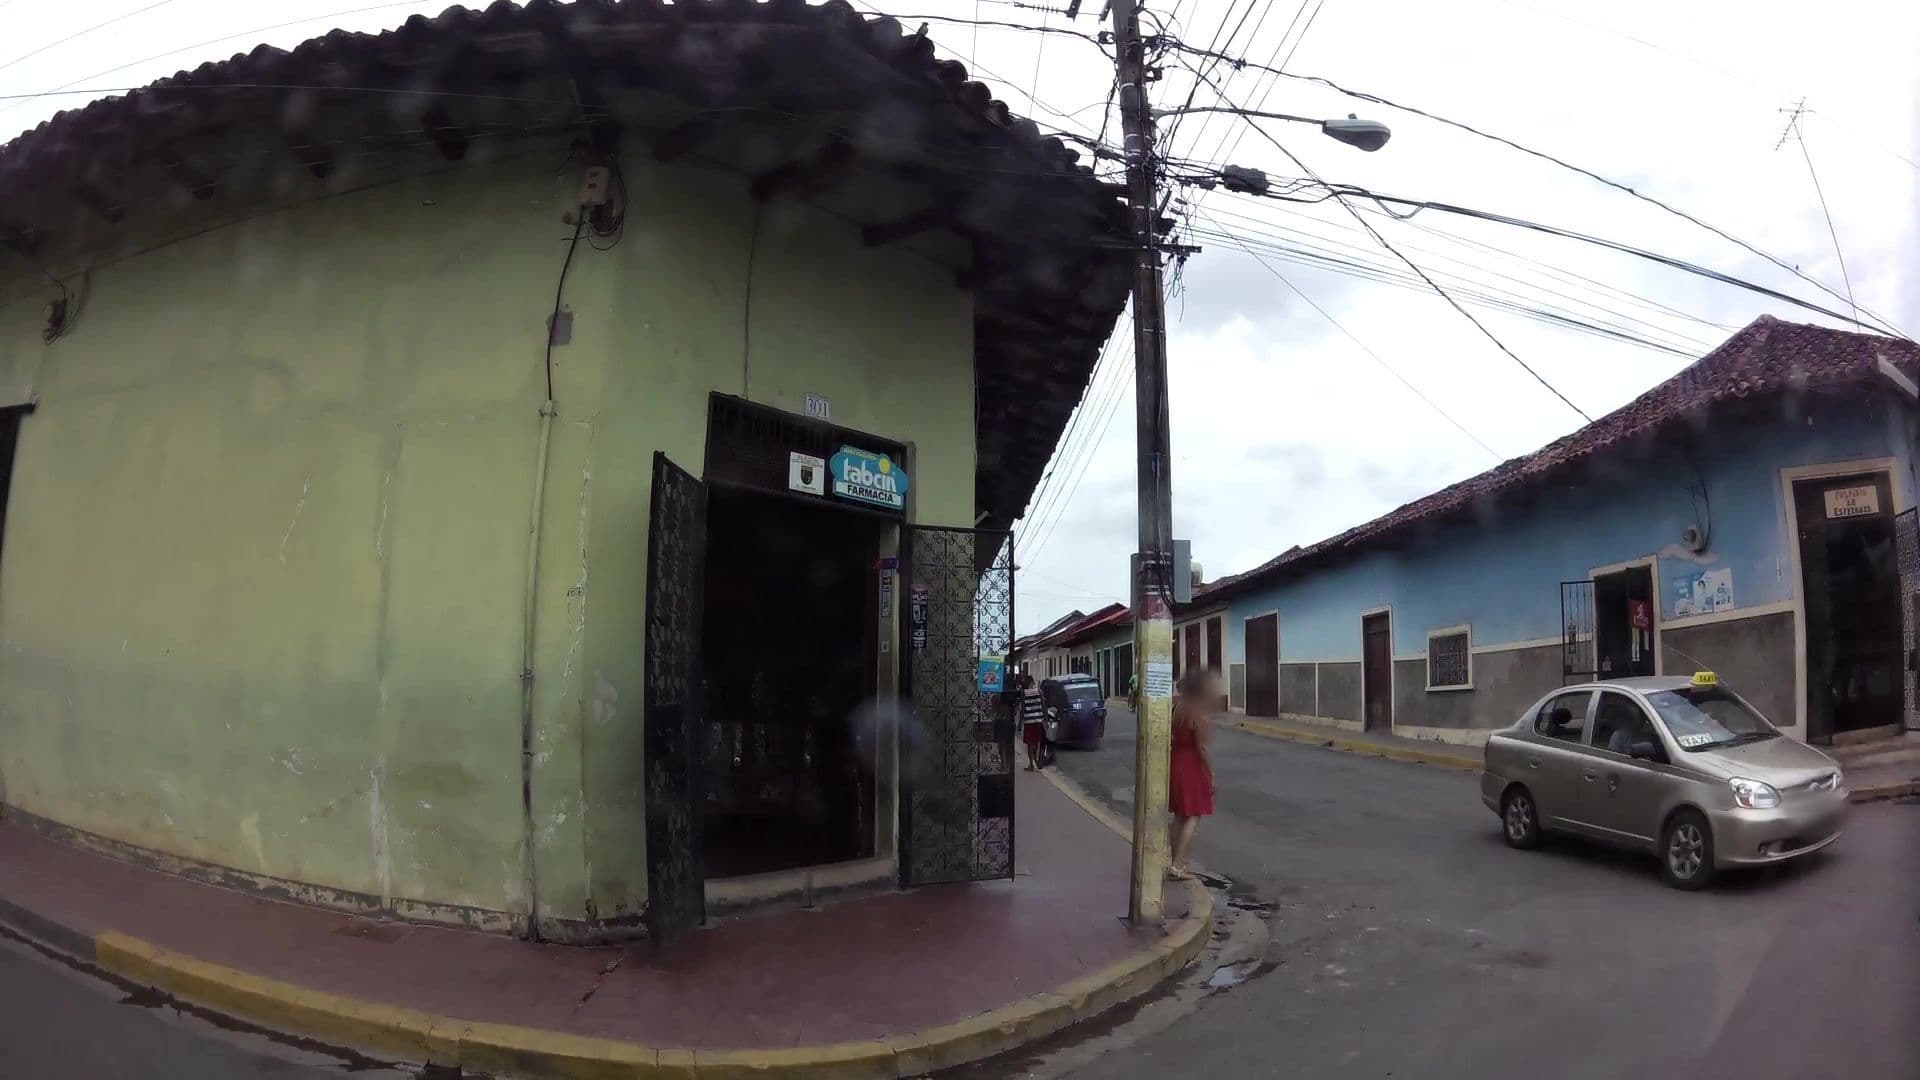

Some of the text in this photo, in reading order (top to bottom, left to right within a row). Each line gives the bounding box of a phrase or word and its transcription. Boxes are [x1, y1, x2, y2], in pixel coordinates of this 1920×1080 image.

[808, 398, 828, 418] 301
[843, 458, 896, 492] tabcin
[847, 485, 894, 503] FARMACIA
[1699, 675, 1714, 683] TAXI
[1685, 735, 1711, 746] TAXI
